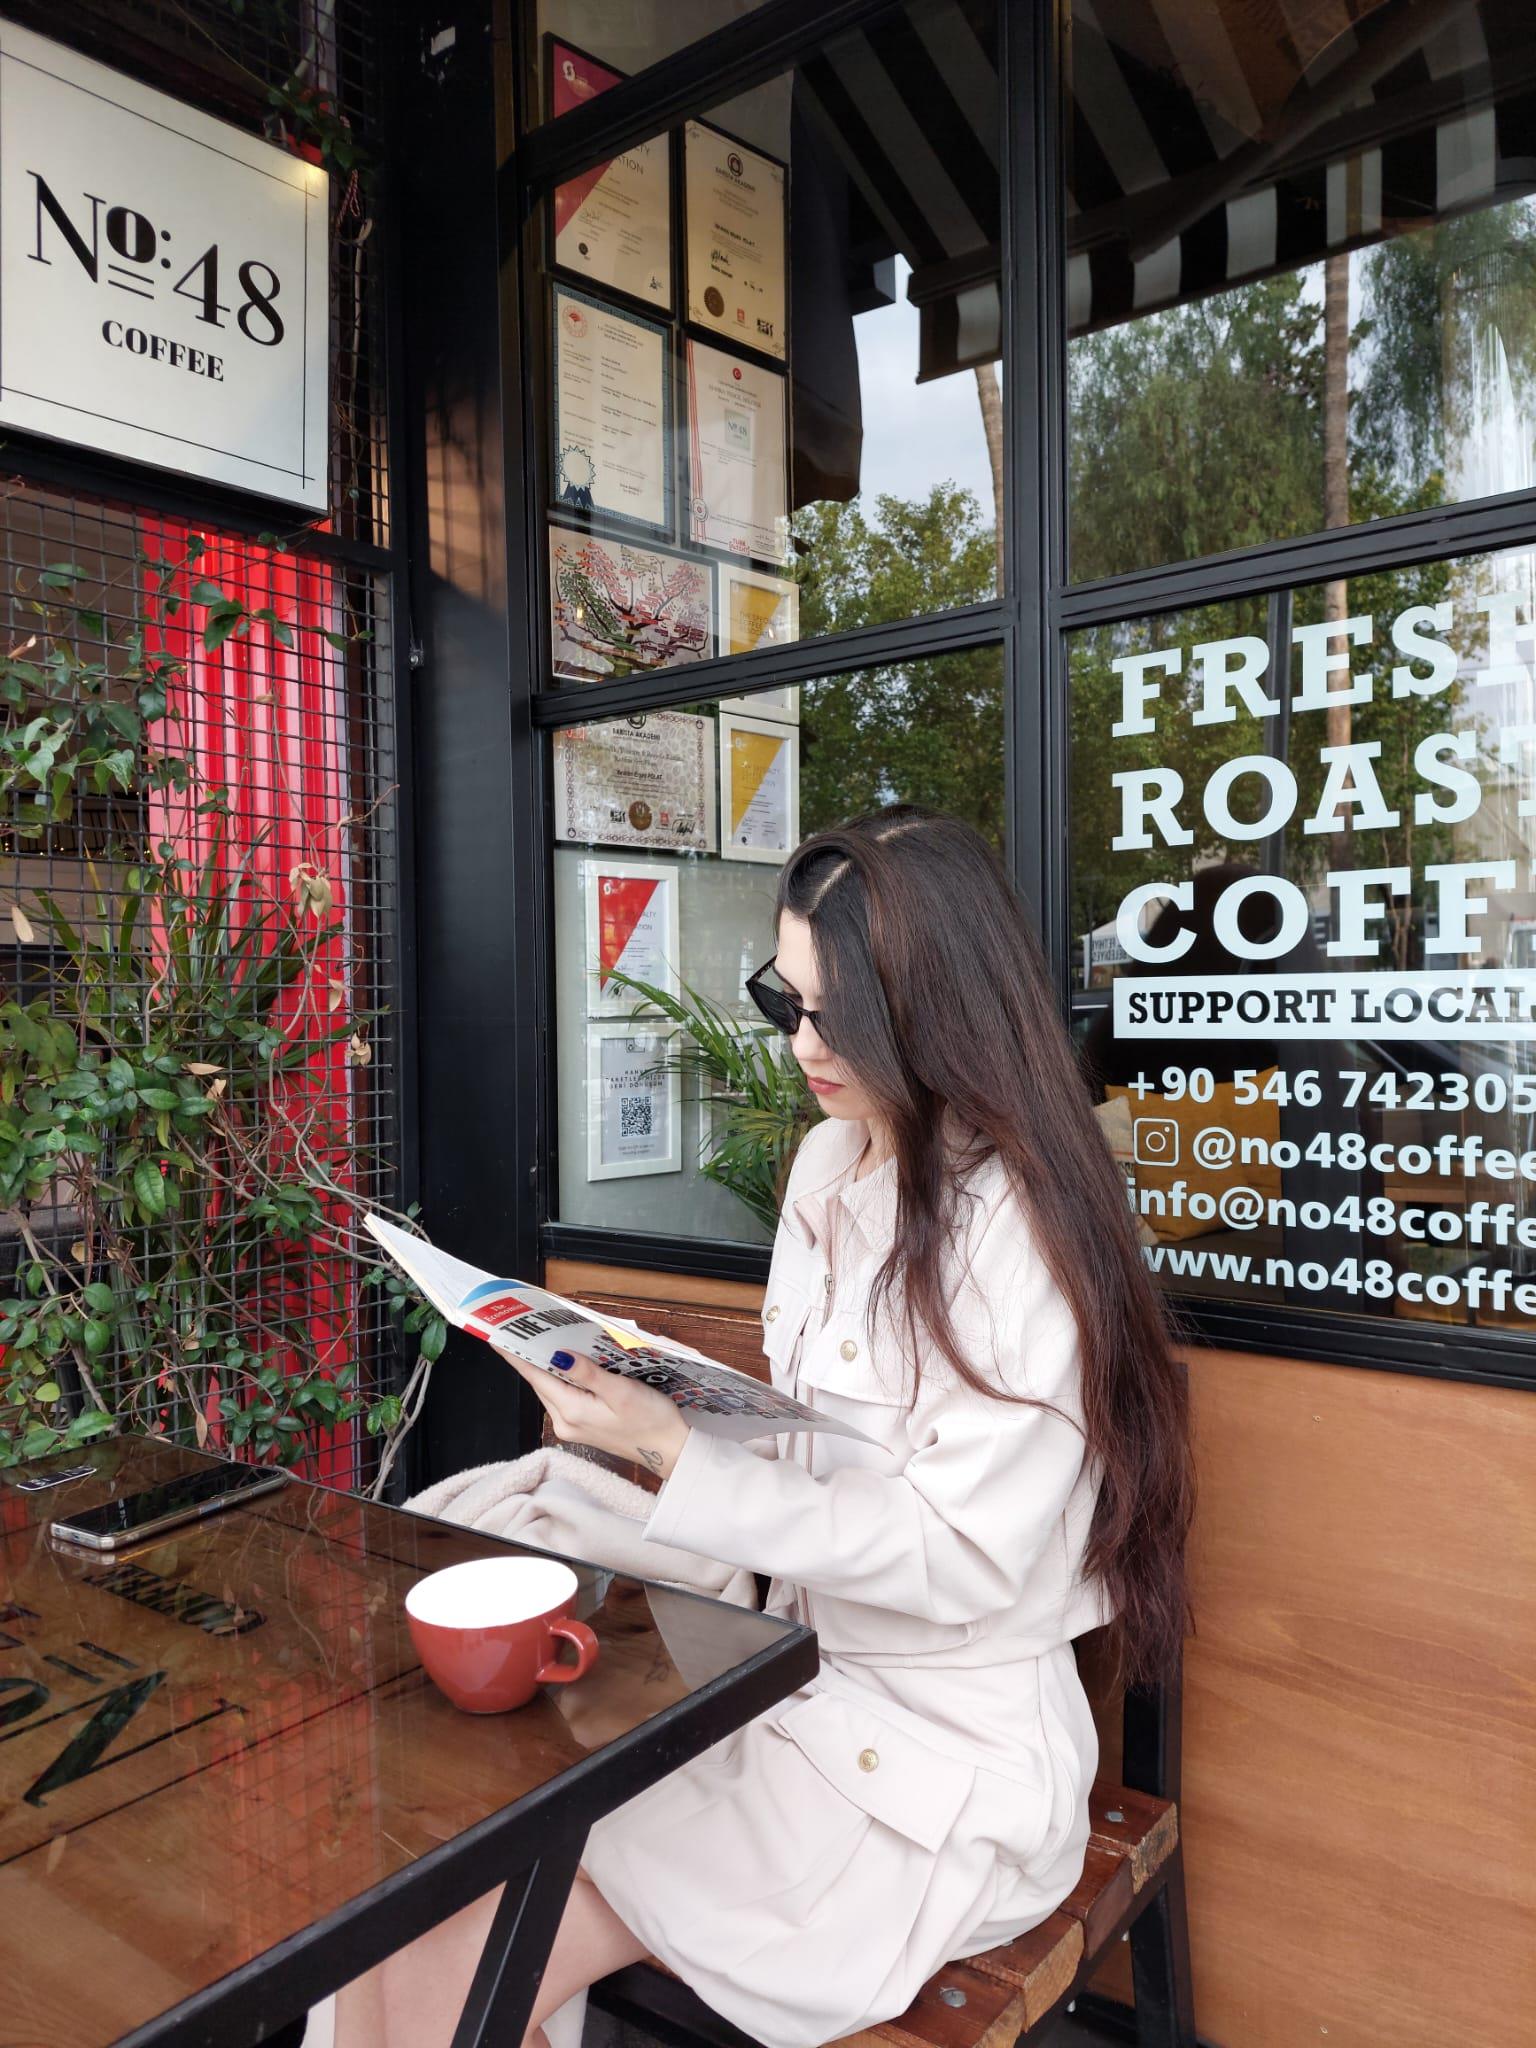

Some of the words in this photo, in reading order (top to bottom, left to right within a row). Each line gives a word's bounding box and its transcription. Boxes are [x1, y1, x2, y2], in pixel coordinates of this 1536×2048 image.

[102, 320, 224, 382] COFFEE
[1129, 989, 1336, 1024] SUPPORT
[1351, 987, 1536, 1023] LOCAL
[1127, 1066, 1215, 1103] +90
[1233, 1069, 1322, 1107] 546
[499, 1315, 552, 1340] THE
